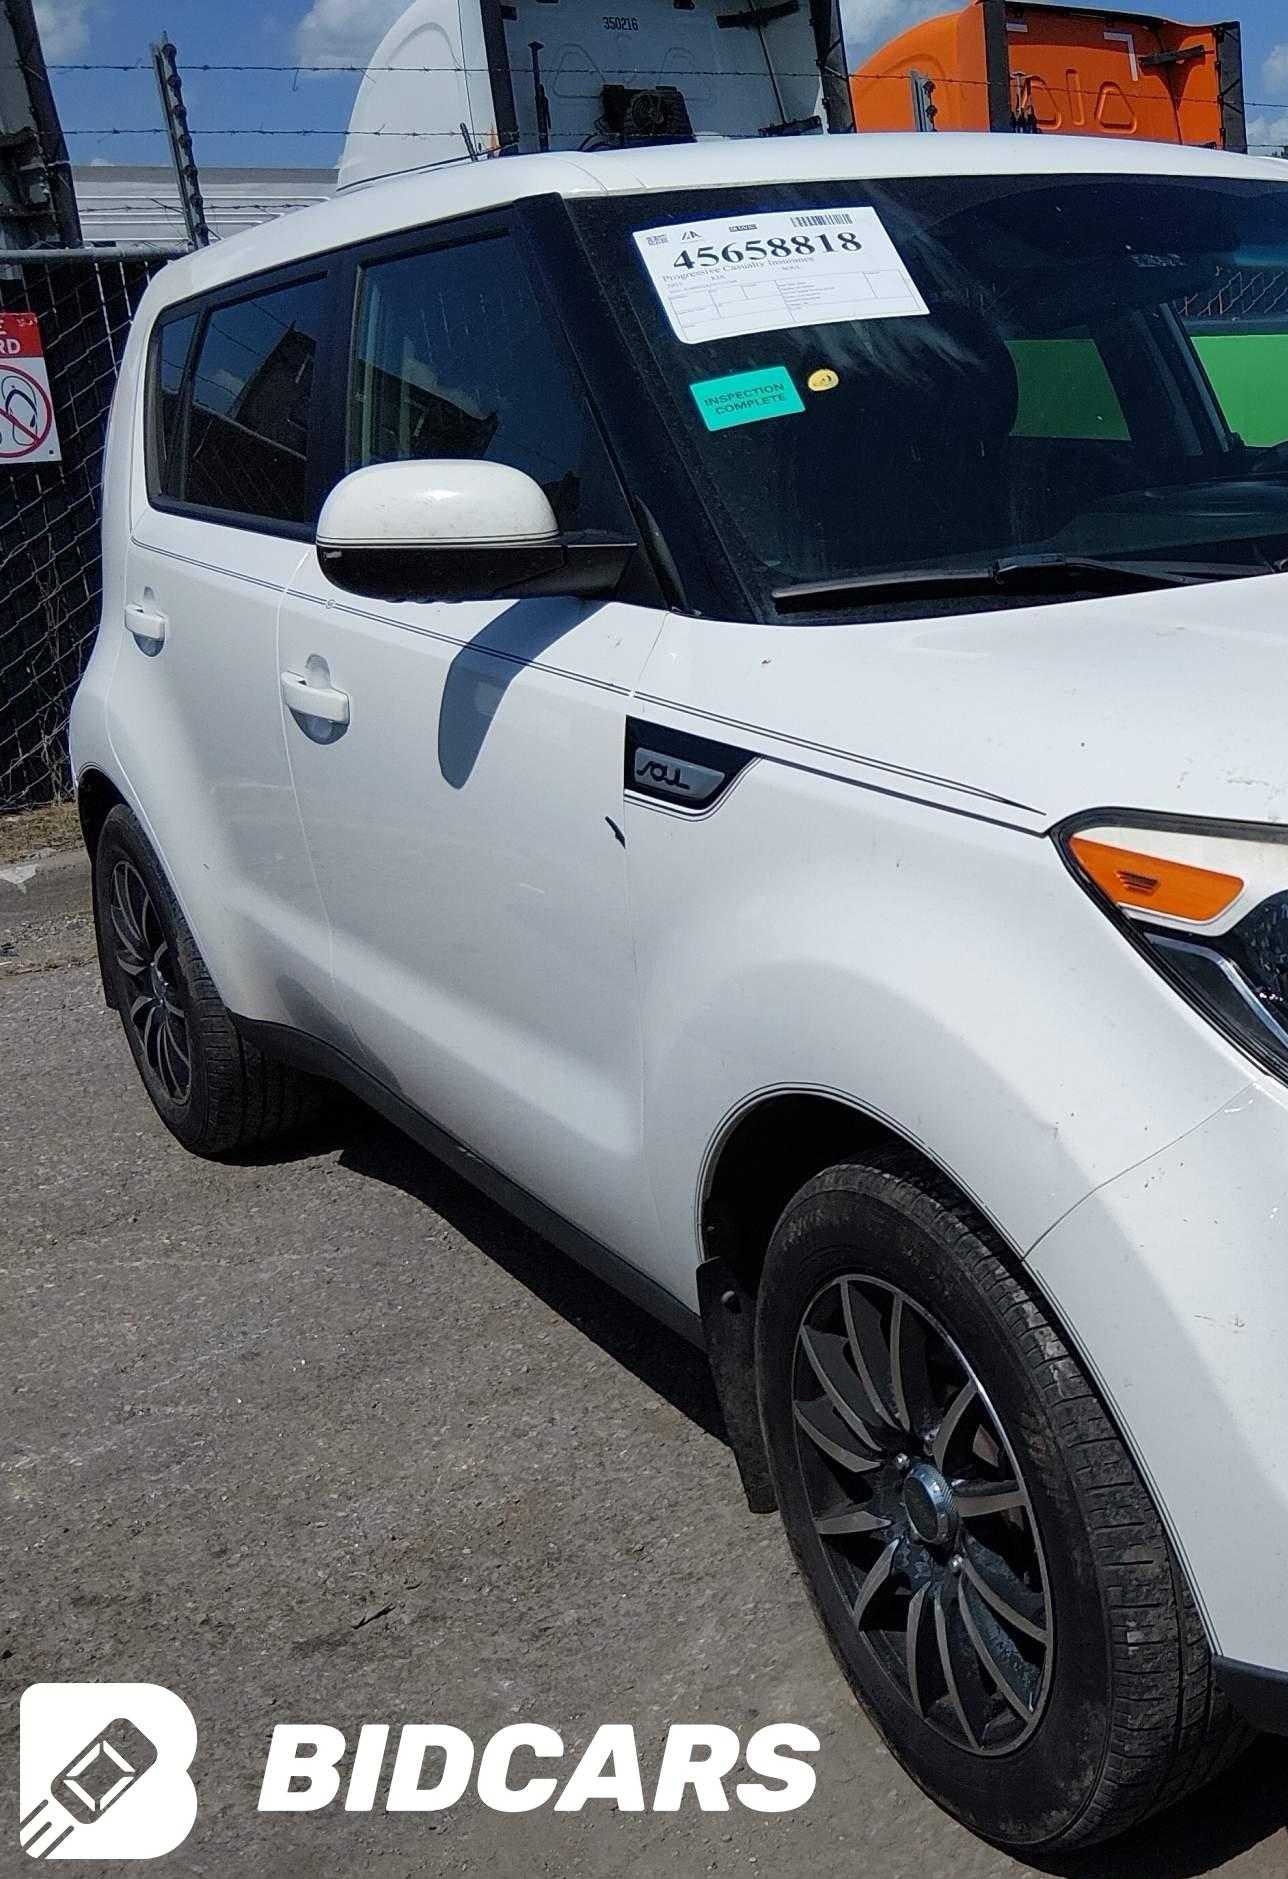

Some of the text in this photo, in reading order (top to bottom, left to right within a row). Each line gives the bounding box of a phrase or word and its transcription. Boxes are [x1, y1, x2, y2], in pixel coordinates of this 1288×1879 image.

[603, 16, 639, 32] 350216
[673, 231, 863, 270] 45658818
[662, 256, 816, 282] Progressive Casualty Insurance
[703, 383, 785, 407] INSPECTION
[715, 393, 787, 415] COMPLETE
